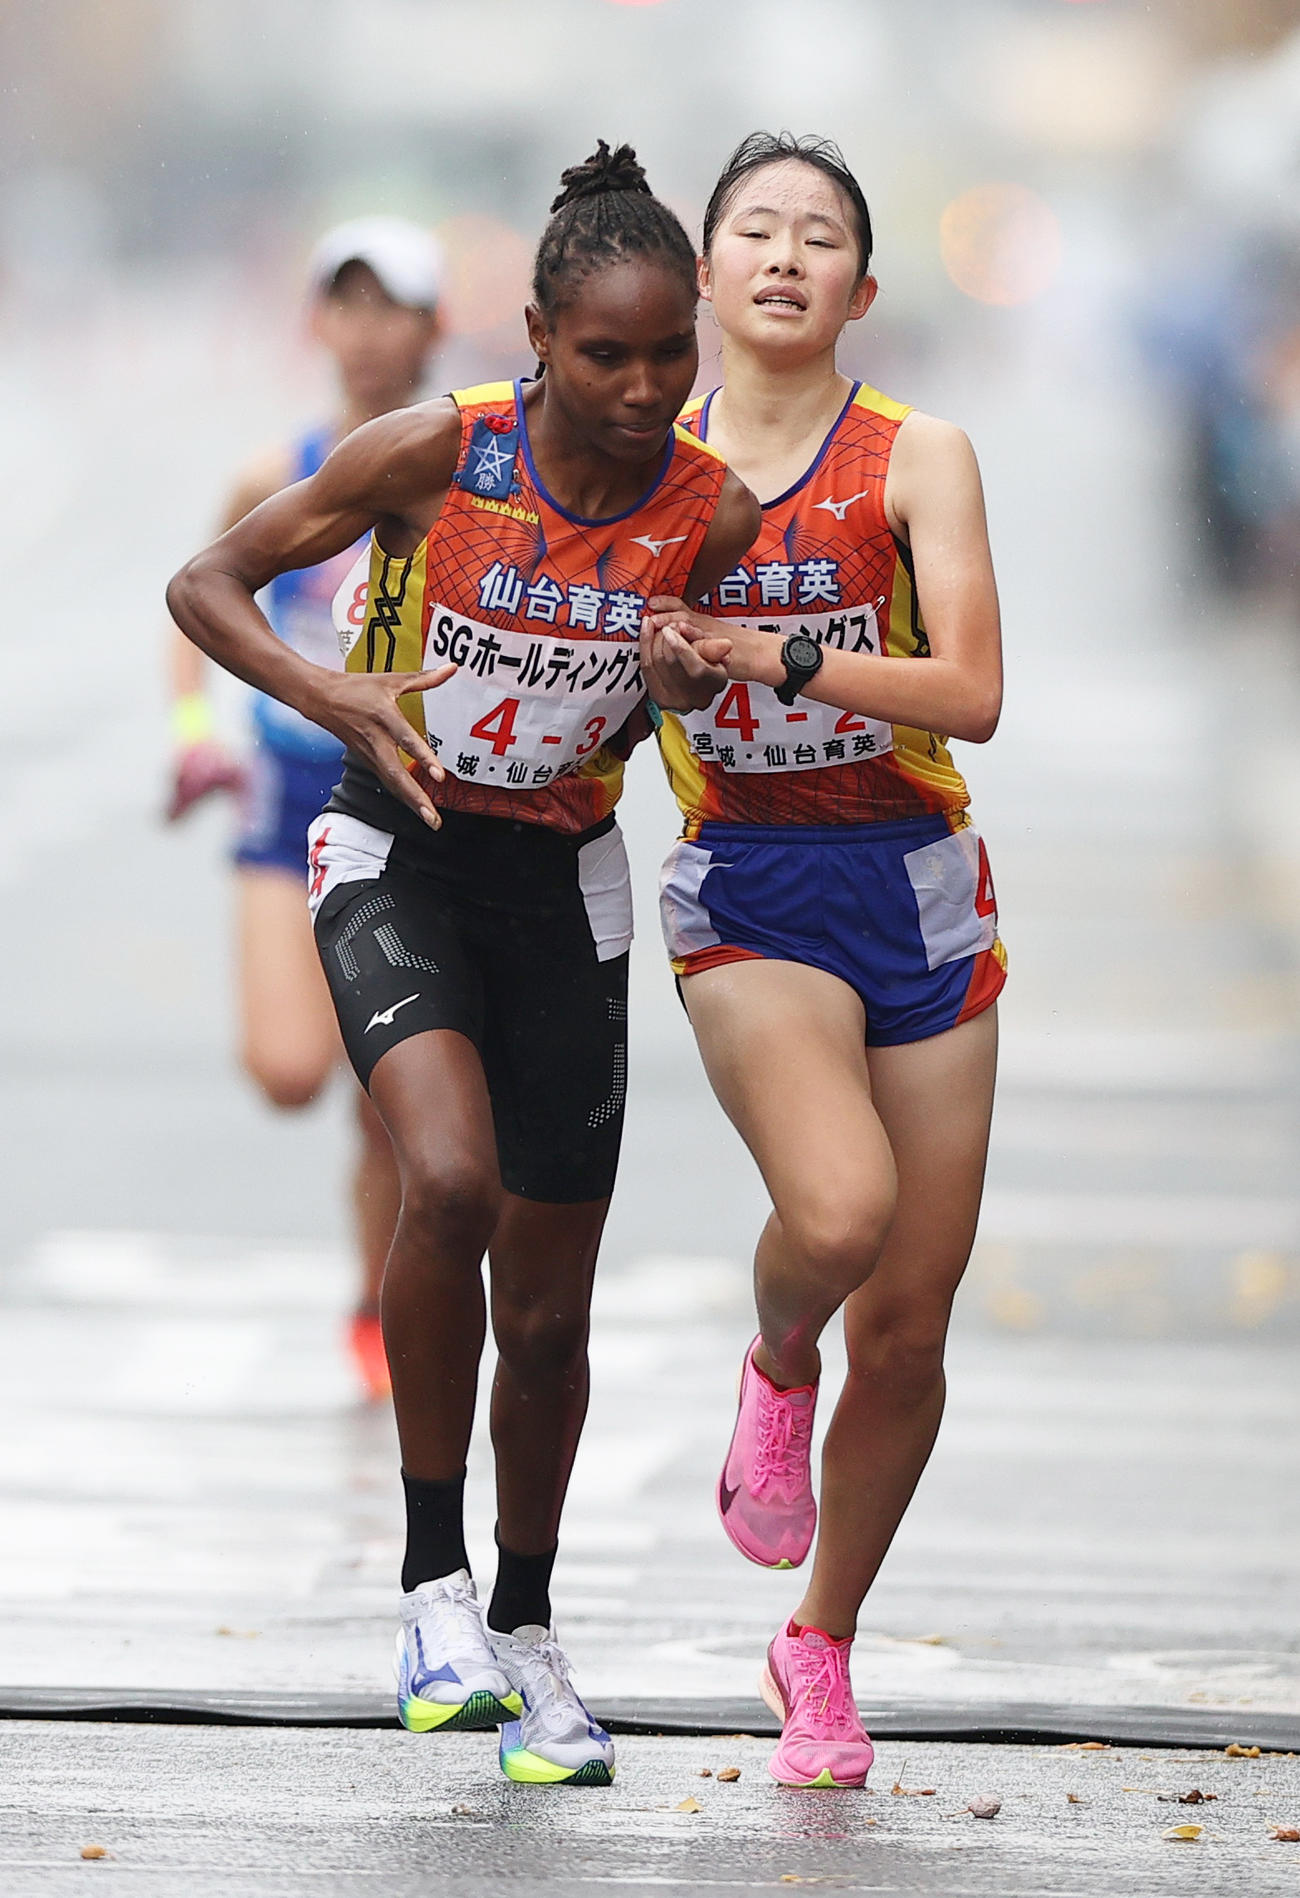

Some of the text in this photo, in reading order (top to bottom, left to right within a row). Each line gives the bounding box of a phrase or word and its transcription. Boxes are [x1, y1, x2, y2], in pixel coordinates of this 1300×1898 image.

[480, 562, 646, 639] 仙台育英
[698, 560, 842, 606] 台育英
[433, 615, 646, 695] SGホールディングス
